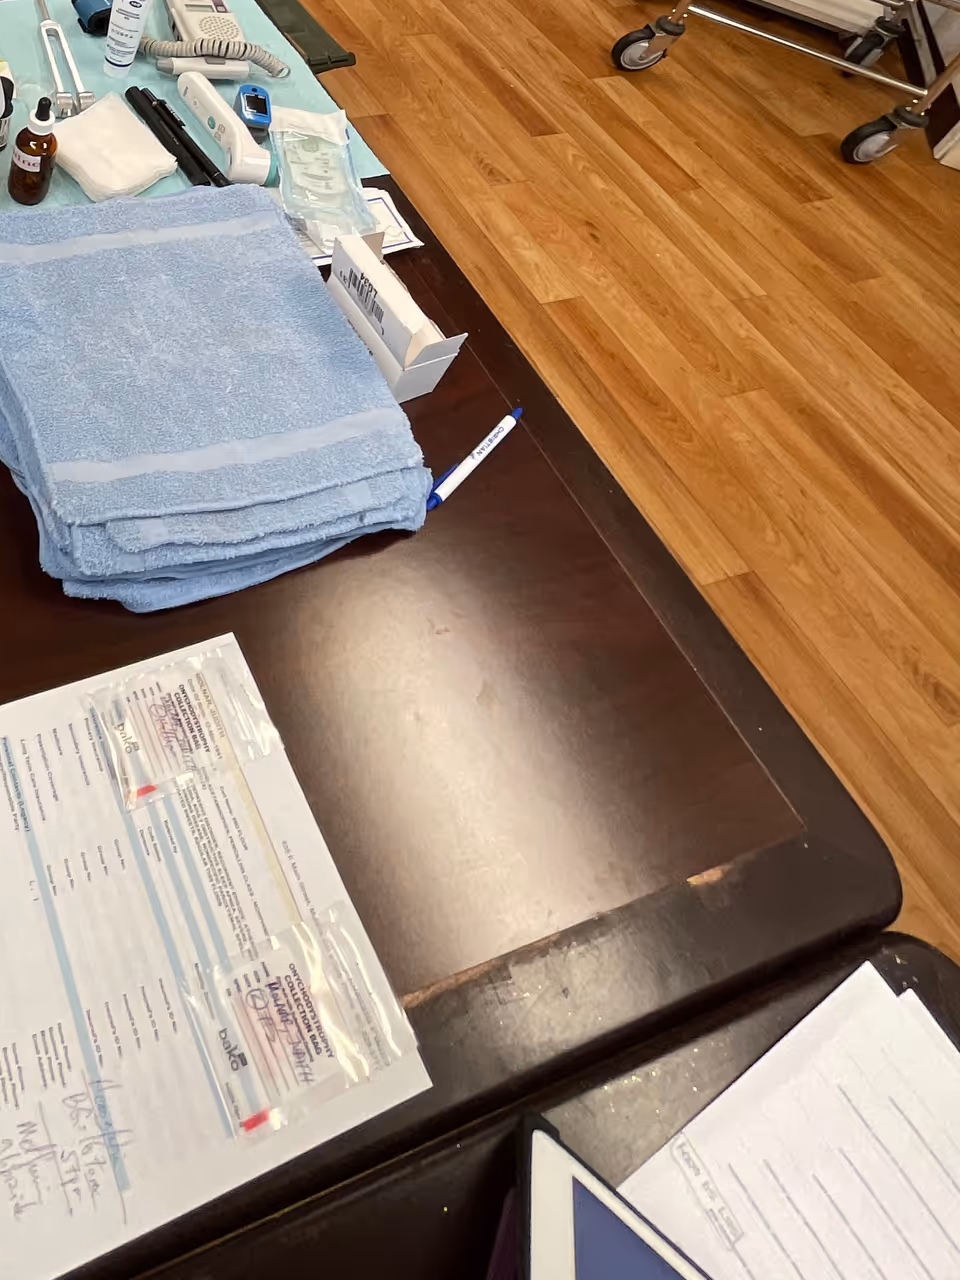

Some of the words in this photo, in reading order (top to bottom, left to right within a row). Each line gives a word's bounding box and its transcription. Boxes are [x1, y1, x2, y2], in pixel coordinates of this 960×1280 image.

[474, 422, 506, 460] CHRISTIAN
[172, 691, 195, 734] COLLECTION
[177, 682, 211, 754] ONYCHODYSTROPHY
[0, 735, 14, 768] Personal
[8, 767, 23, 800] Contacts
[16, 799, 31, 833] (Legacy)
[283, 973, 313, 1034] COLLECTION
[308, 1032, 323, 1056] BAG
[286, 960, 335, 1061] ONYCHODYSTROPHY
[217, 1025, 245, 1073] bako
